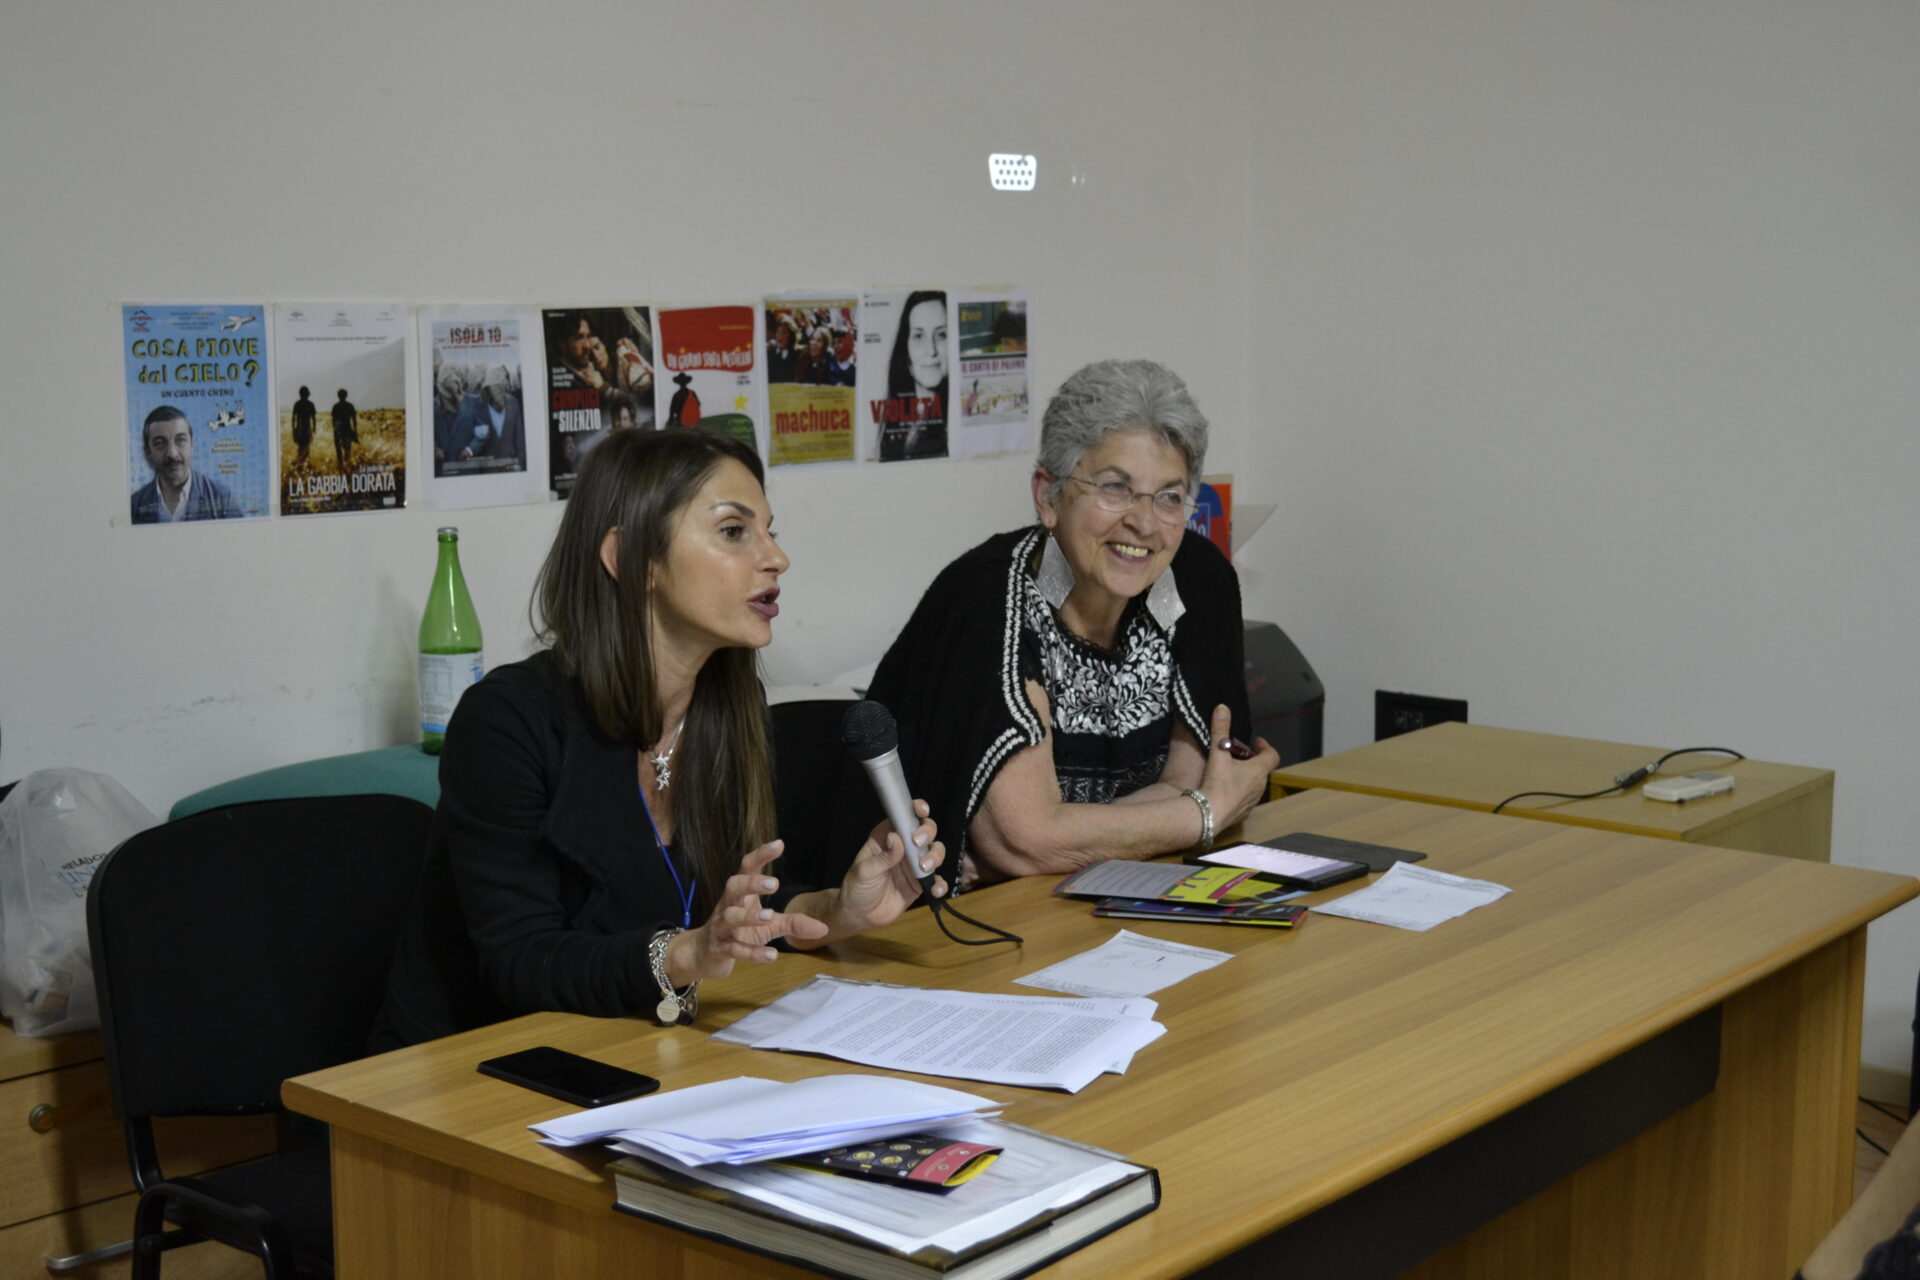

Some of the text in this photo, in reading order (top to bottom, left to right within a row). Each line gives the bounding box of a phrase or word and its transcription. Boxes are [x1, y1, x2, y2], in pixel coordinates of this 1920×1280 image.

[450, 327, 484, 344] ISOLA
[487, 326, 502, 343] 10
[132, 337, 259, 358] COSA PIOVE
[138, 359, 260, 387] dal CIELO?
[161, 388, 235, 398] UN CUENTO CHINO
[559, 408, 601, 432] SILENZIO
[775, 402, 850, 435] machuca
[870, 394, 944, 424] VIOLETA
[289, 472, 396, 496] LA GABBIA DORATA
